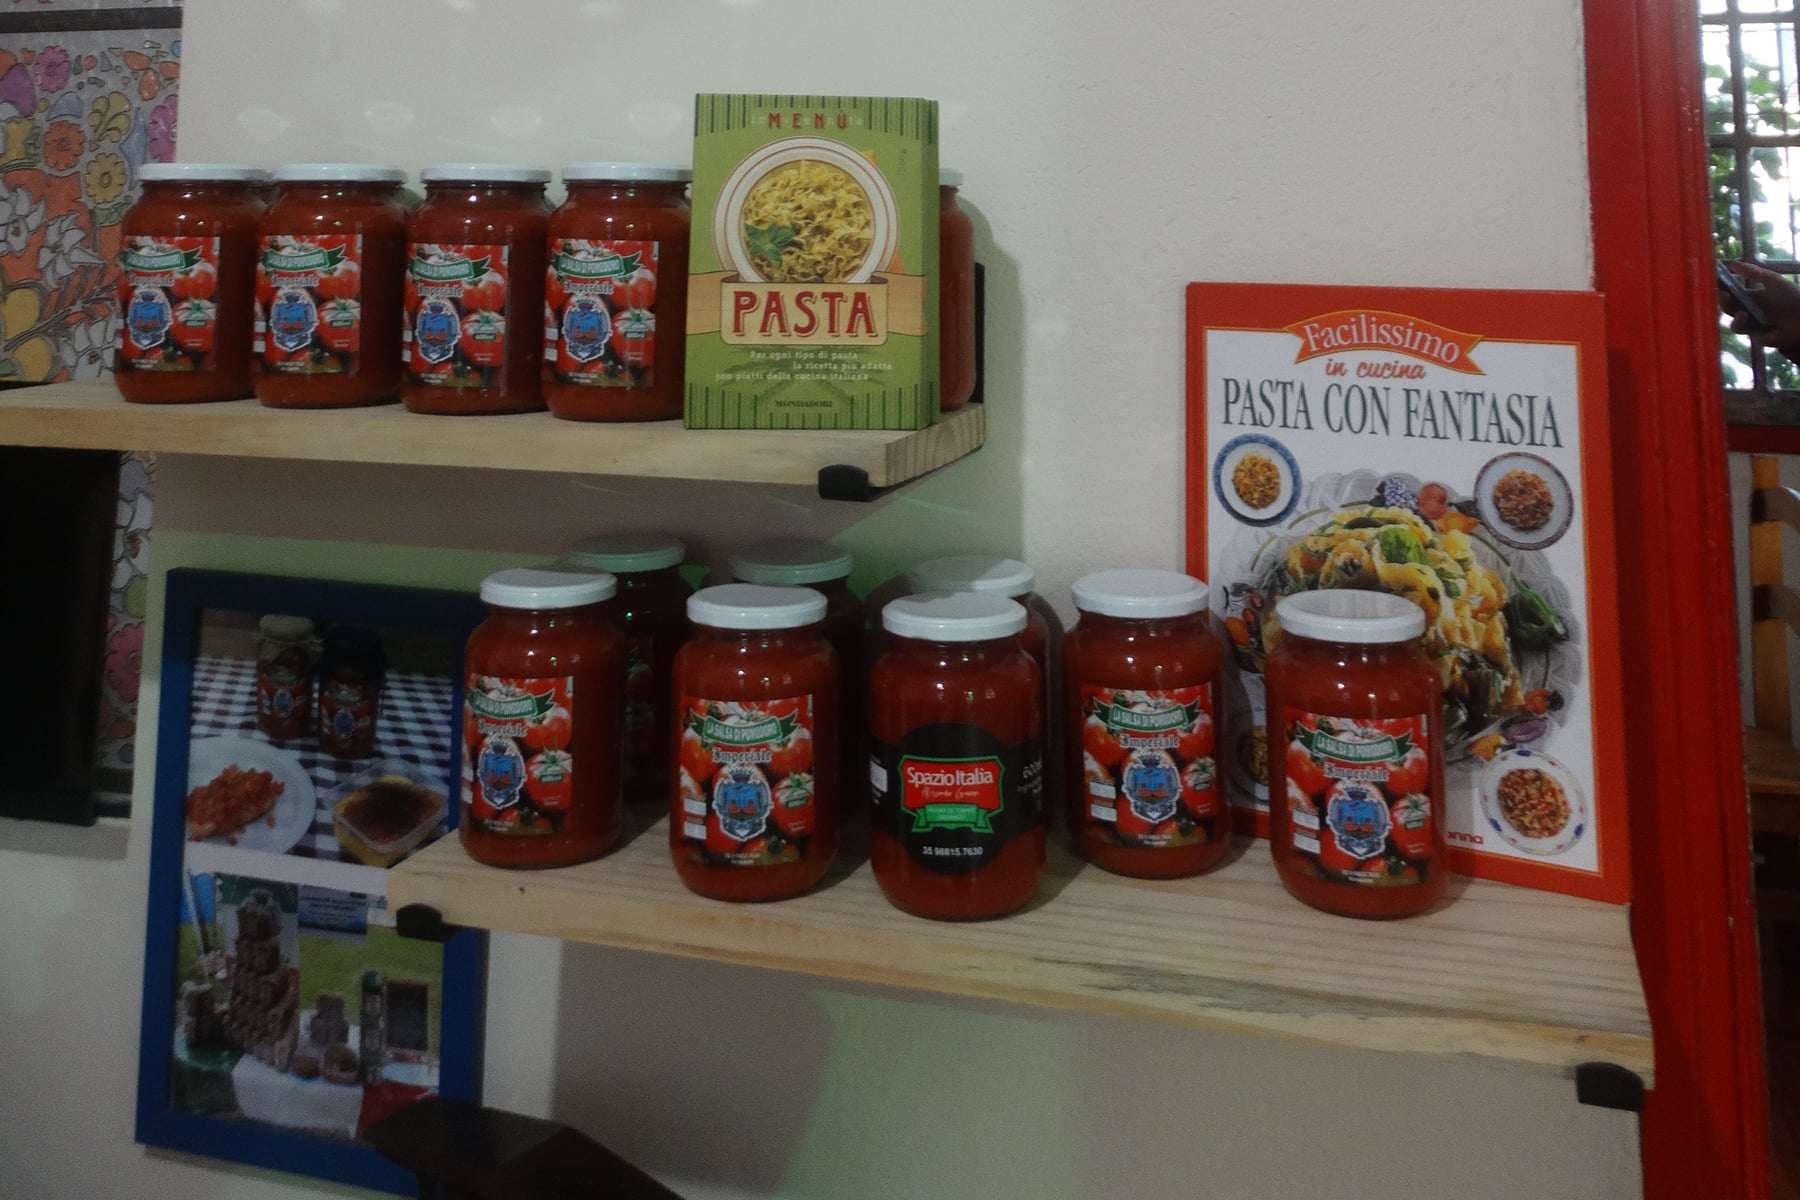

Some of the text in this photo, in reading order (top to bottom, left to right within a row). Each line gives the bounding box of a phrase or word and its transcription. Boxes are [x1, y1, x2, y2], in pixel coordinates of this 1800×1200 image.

[732, 290, 878, 337] PASTA
[1303, 315, 1460, 363] Facilissimo
[769, 352, 792, 362] ogni
[795, 351, 816, 362] tipo
[818, 351, 830, 360] di
[832, 352, 858, 362] pasta
[793, 361, 803, 370] la
[805, 362, 838, 371] ricetta
[1325, 359, 1426, 380] in cucina
[1221, 378, 1565, 449] PASTA CON FANTASIA
[922, 846, 933, 855] 35
